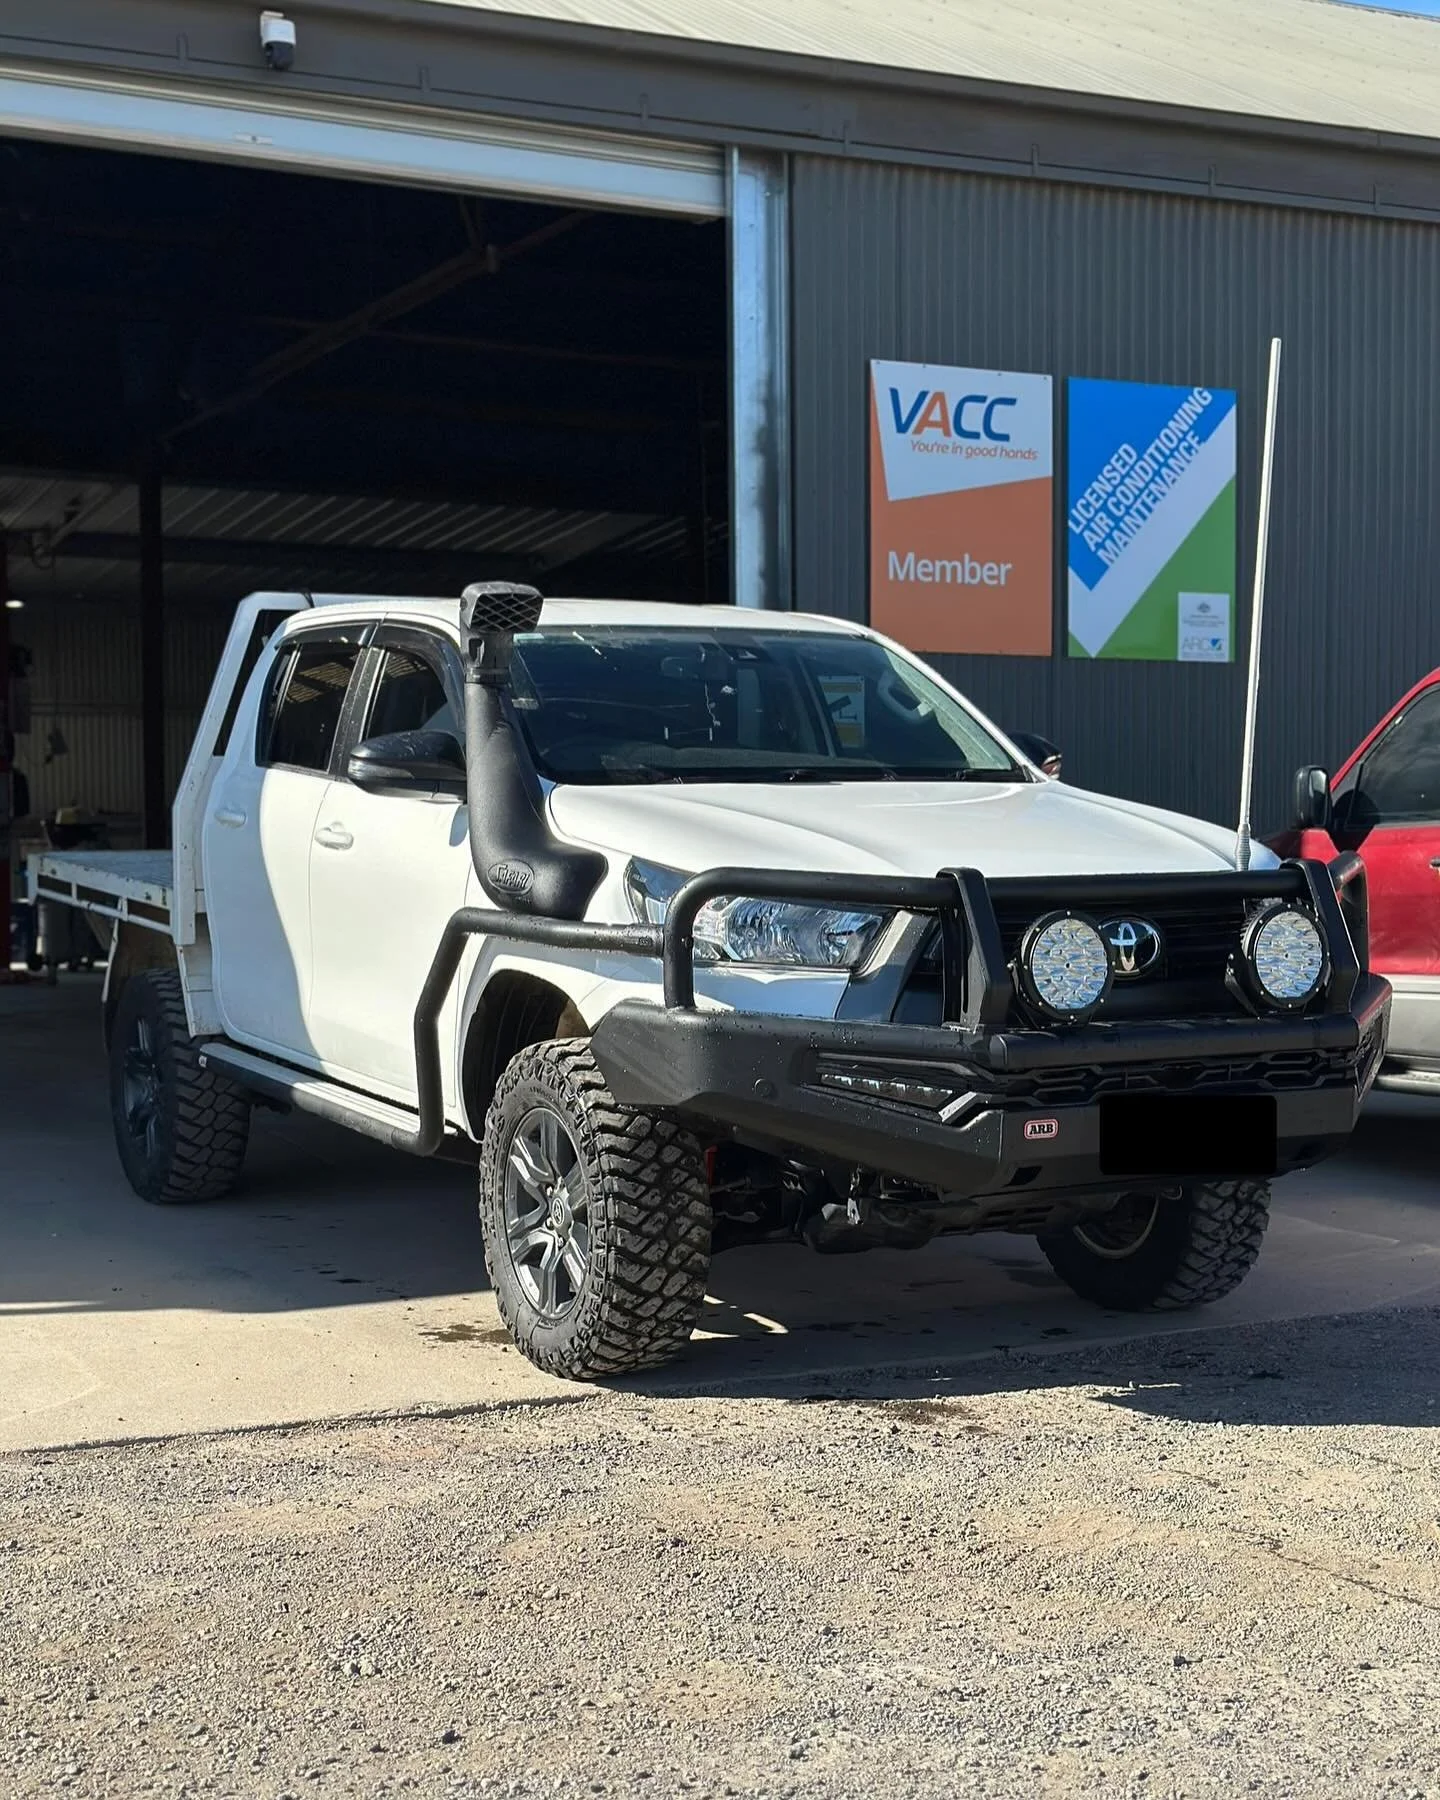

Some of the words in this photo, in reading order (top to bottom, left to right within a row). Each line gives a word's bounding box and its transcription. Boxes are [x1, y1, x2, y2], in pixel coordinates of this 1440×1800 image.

[889, 387, 1017, 442] VACC
[911, 440, 949, 454] You're
[951, 442, 962, 455] in
[965, 445, 997, 459] good
[1000, 446, 1038, 460] hands
[1083, 512, 1115, 552] AIR
[1107, 387, 1212, 517] CONDITIONING
[1068, 443, 1137, 534] LICENSED
[1097, 430, 1201, 567] MAINTENANCE
[888, 551, 1012, 585] Member
[1029, 1123, 1054, 1135] ARB
